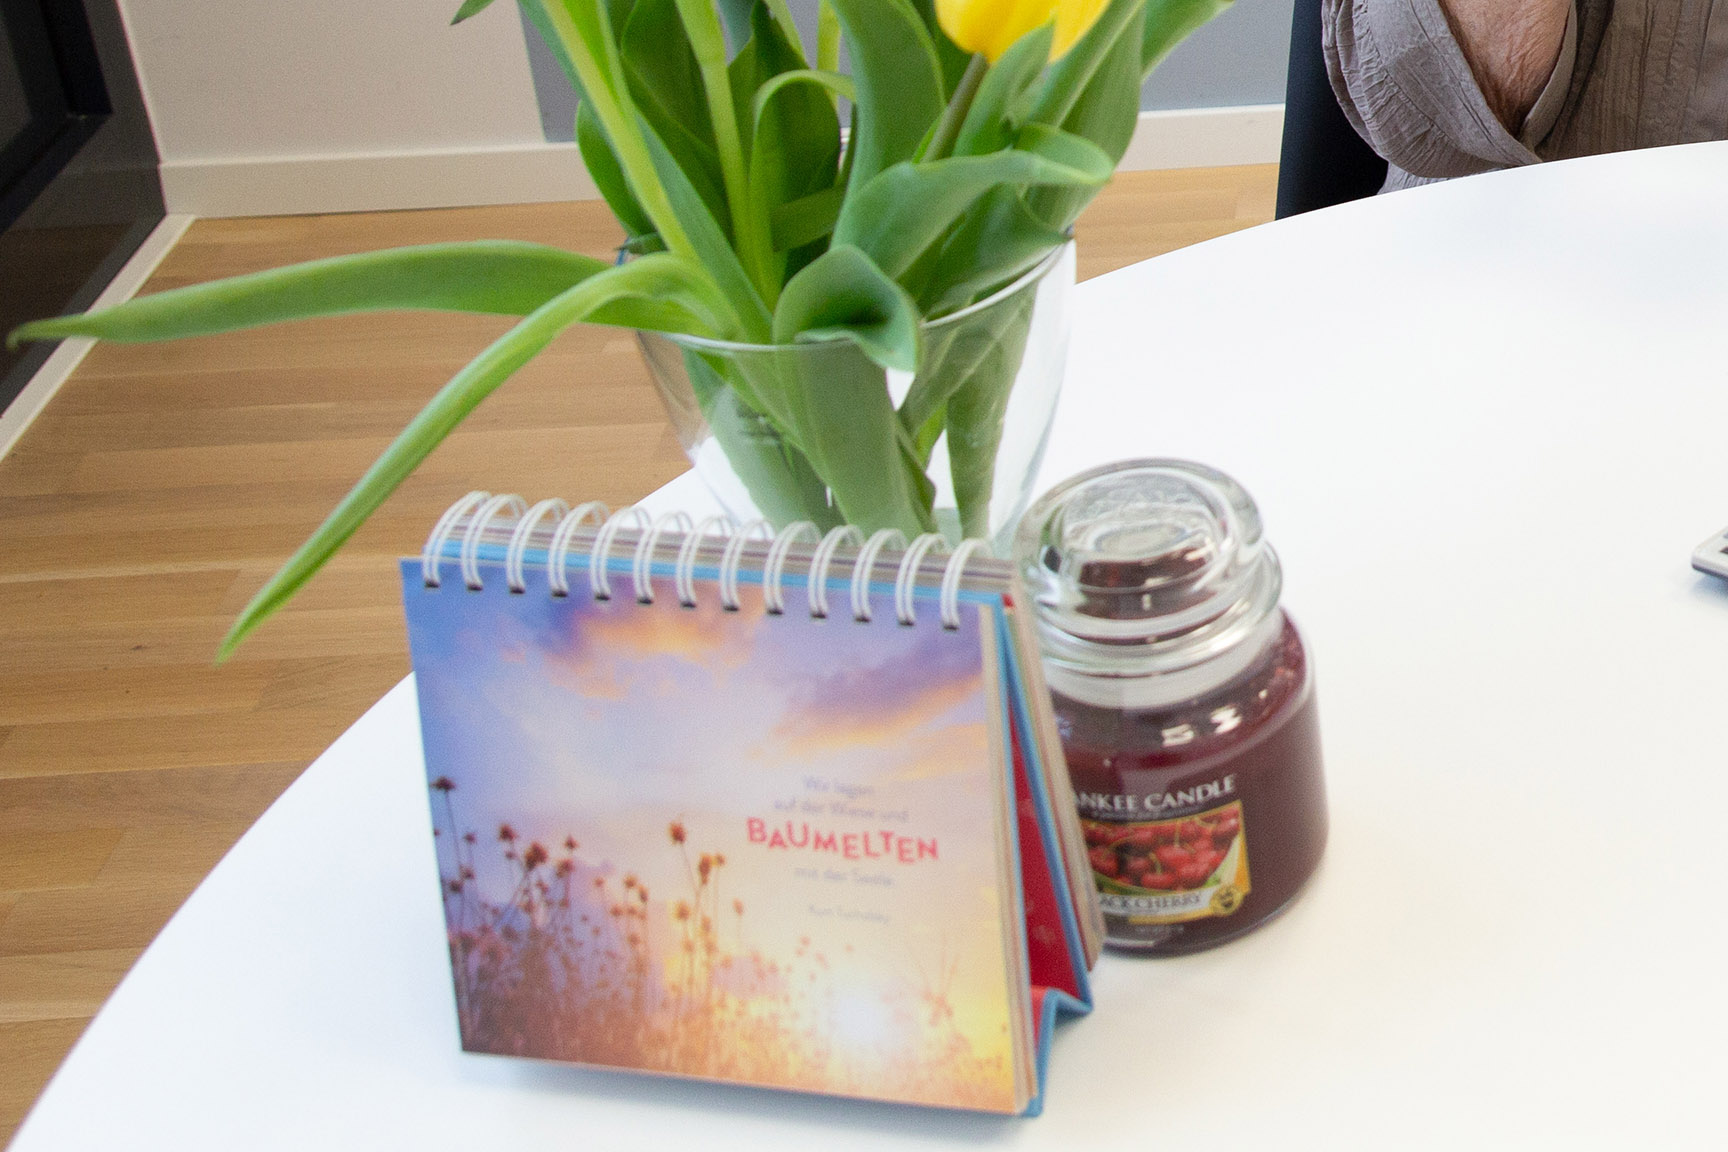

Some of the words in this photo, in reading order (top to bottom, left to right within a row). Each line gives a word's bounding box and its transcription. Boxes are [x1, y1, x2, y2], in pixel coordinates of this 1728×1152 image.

[1073, 791, 1138, 812] NKEE
[1144, 773, 1238, 809] CANDLE
[747, 816, 939, 865] BAUMELTEN
